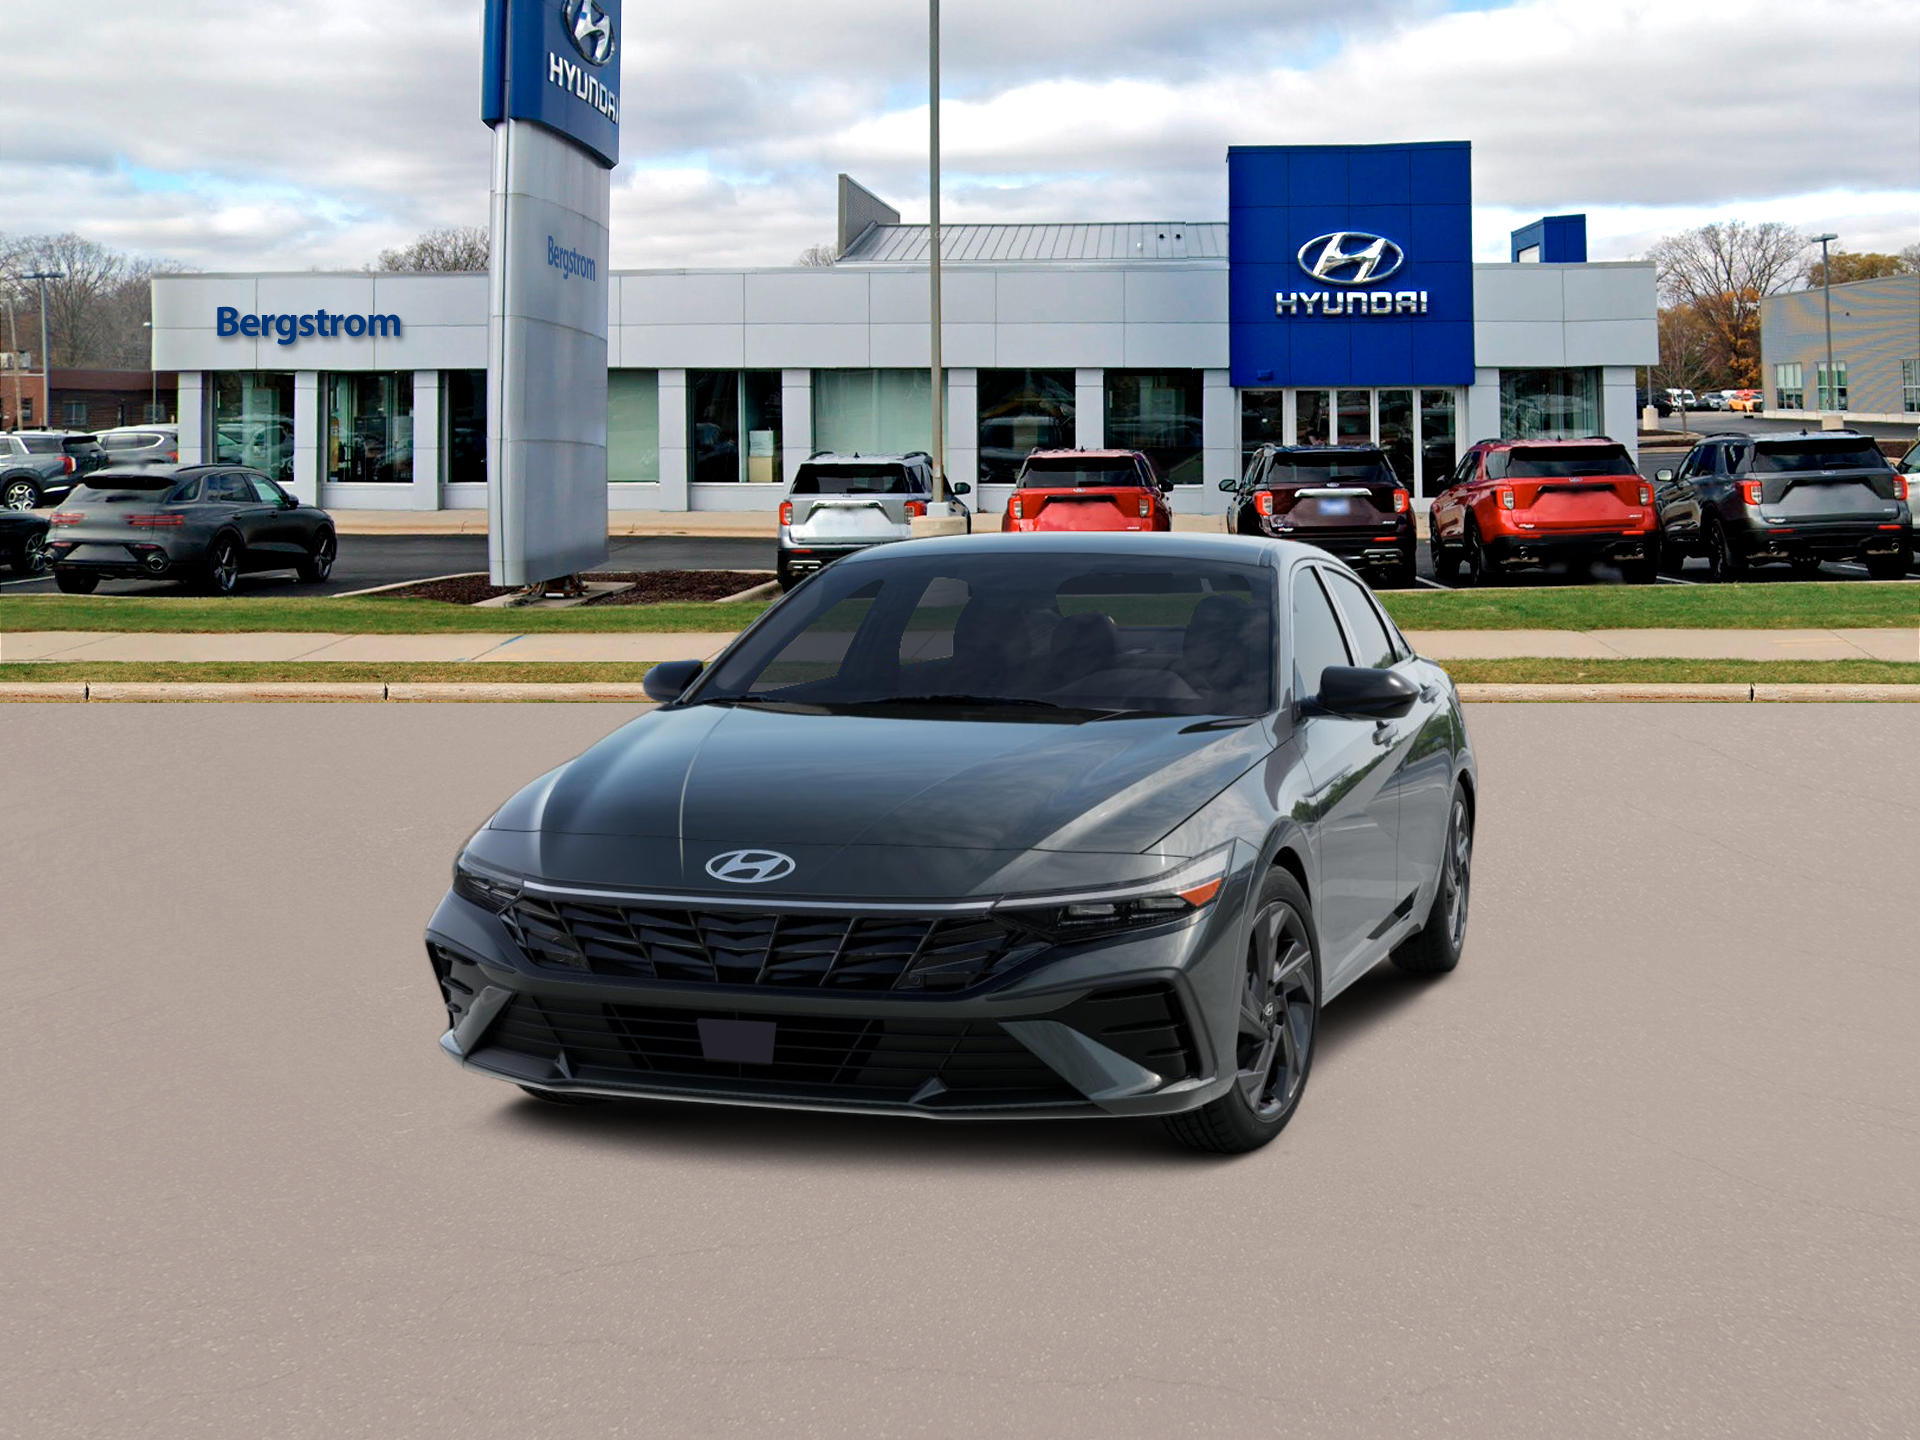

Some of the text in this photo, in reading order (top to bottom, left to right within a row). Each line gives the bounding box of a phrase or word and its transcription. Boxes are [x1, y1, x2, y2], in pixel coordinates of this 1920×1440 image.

[549, 52, 619, 124] HYUNDAI
[547, 235, 596, 282] Bergstrom
[1275, 291, 1428, 315] HYUNDAI
[216, 306, 401, 346] Bergstrom
